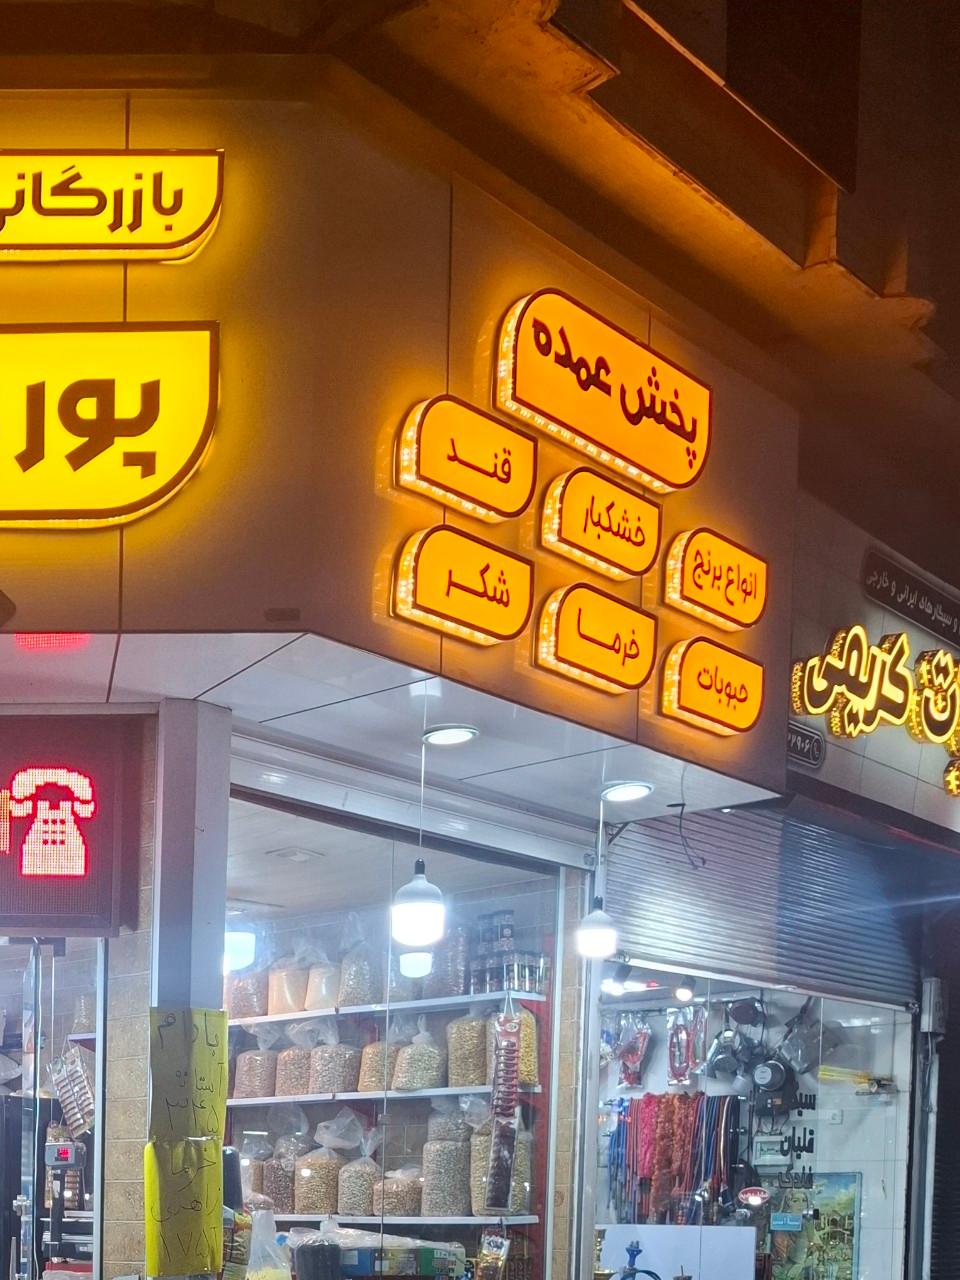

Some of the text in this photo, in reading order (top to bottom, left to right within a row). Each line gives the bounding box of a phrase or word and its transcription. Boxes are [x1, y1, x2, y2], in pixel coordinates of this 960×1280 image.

[532, 317, 698, 470] پخش عمده
[445, 435, 513, 486] قند
[583, 494, 646, 548] خشکبار
[445, 563, 511, 608] شکر
[691, 547, 758, 606] انواع برنج
[865, 570, 889, 590] خارجی
[890, 580, 897, 597] و
[896, 583, 918, 609] ایرانی
[575, 607, 641, 661] خرما
[696, 664, 749, 705] حبوبات
